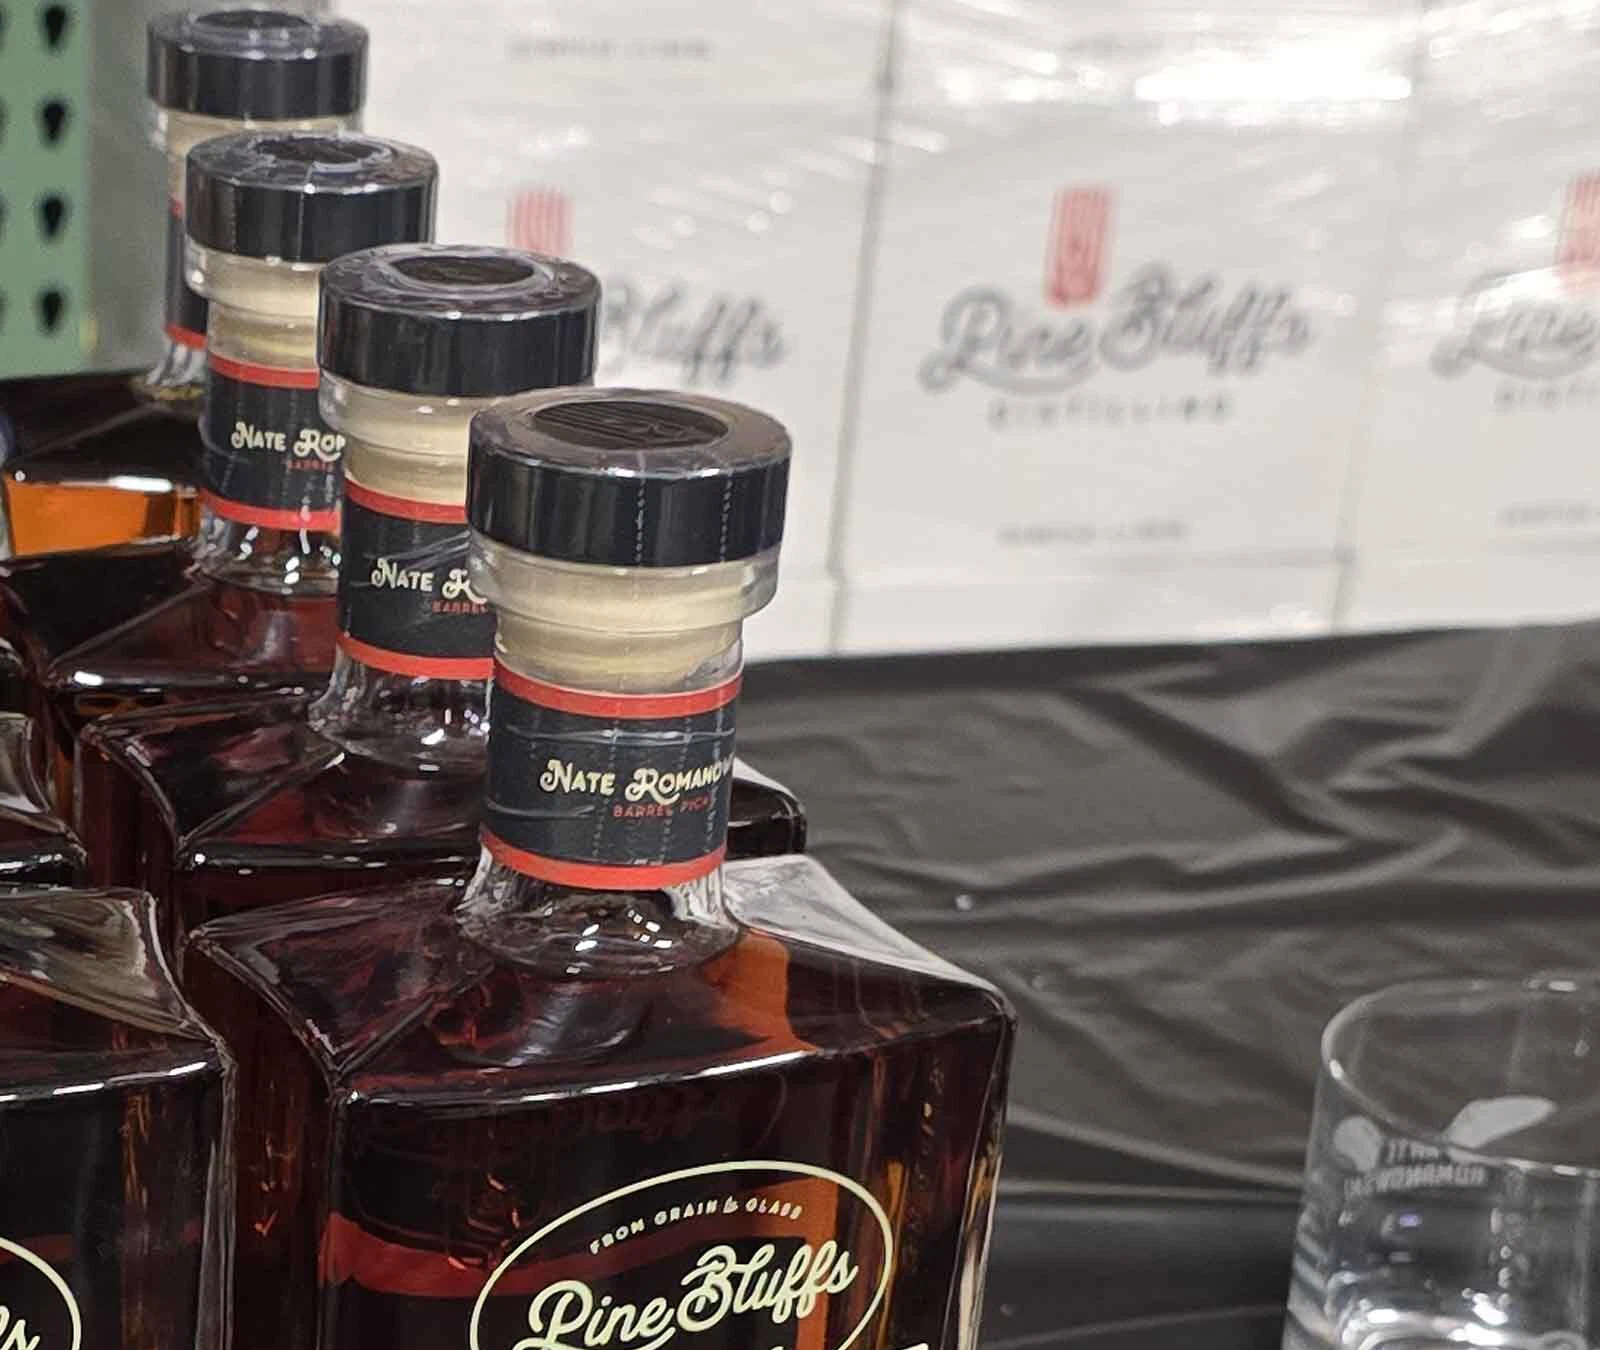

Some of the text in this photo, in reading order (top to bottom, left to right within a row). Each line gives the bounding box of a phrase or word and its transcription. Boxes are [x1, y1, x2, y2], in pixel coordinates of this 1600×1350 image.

[231, 421, 286, 451] NATE
[371, 558, 434, 591] NATE
[539, 759, 616, 796] NATE
[589, 1217, 645, 1254] FROM
[654, 1199, 718, 1226] GRAIN
[676, 1241, 858, 1332] Bluffs
